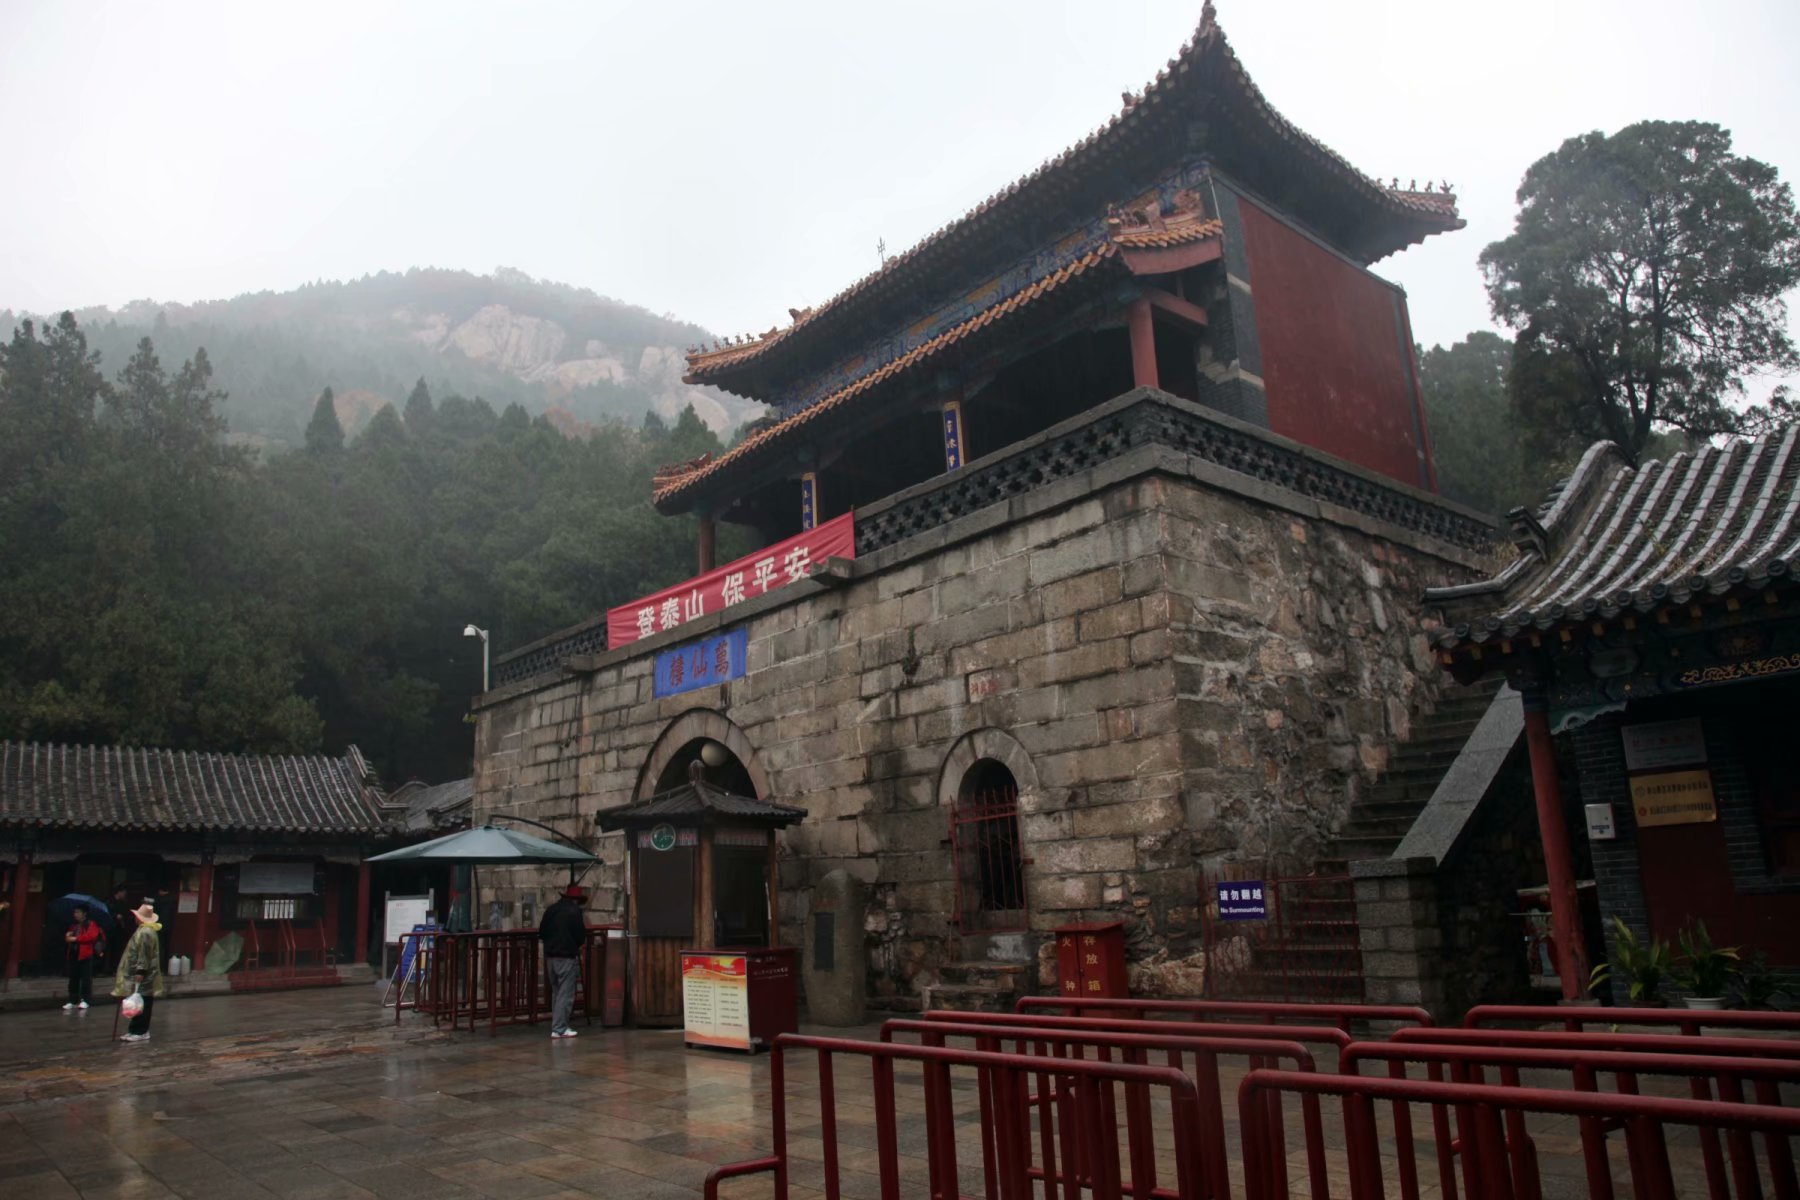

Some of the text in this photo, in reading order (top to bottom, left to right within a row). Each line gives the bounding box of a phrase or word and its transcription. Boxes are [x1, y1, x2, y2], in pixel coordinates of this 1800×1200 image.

[636, 546, 811, 640] 登泰山 保平安
[1219, 888, 1262, 901] 请勿翻越
[1229, 906, 1264, 914] Surmounting
